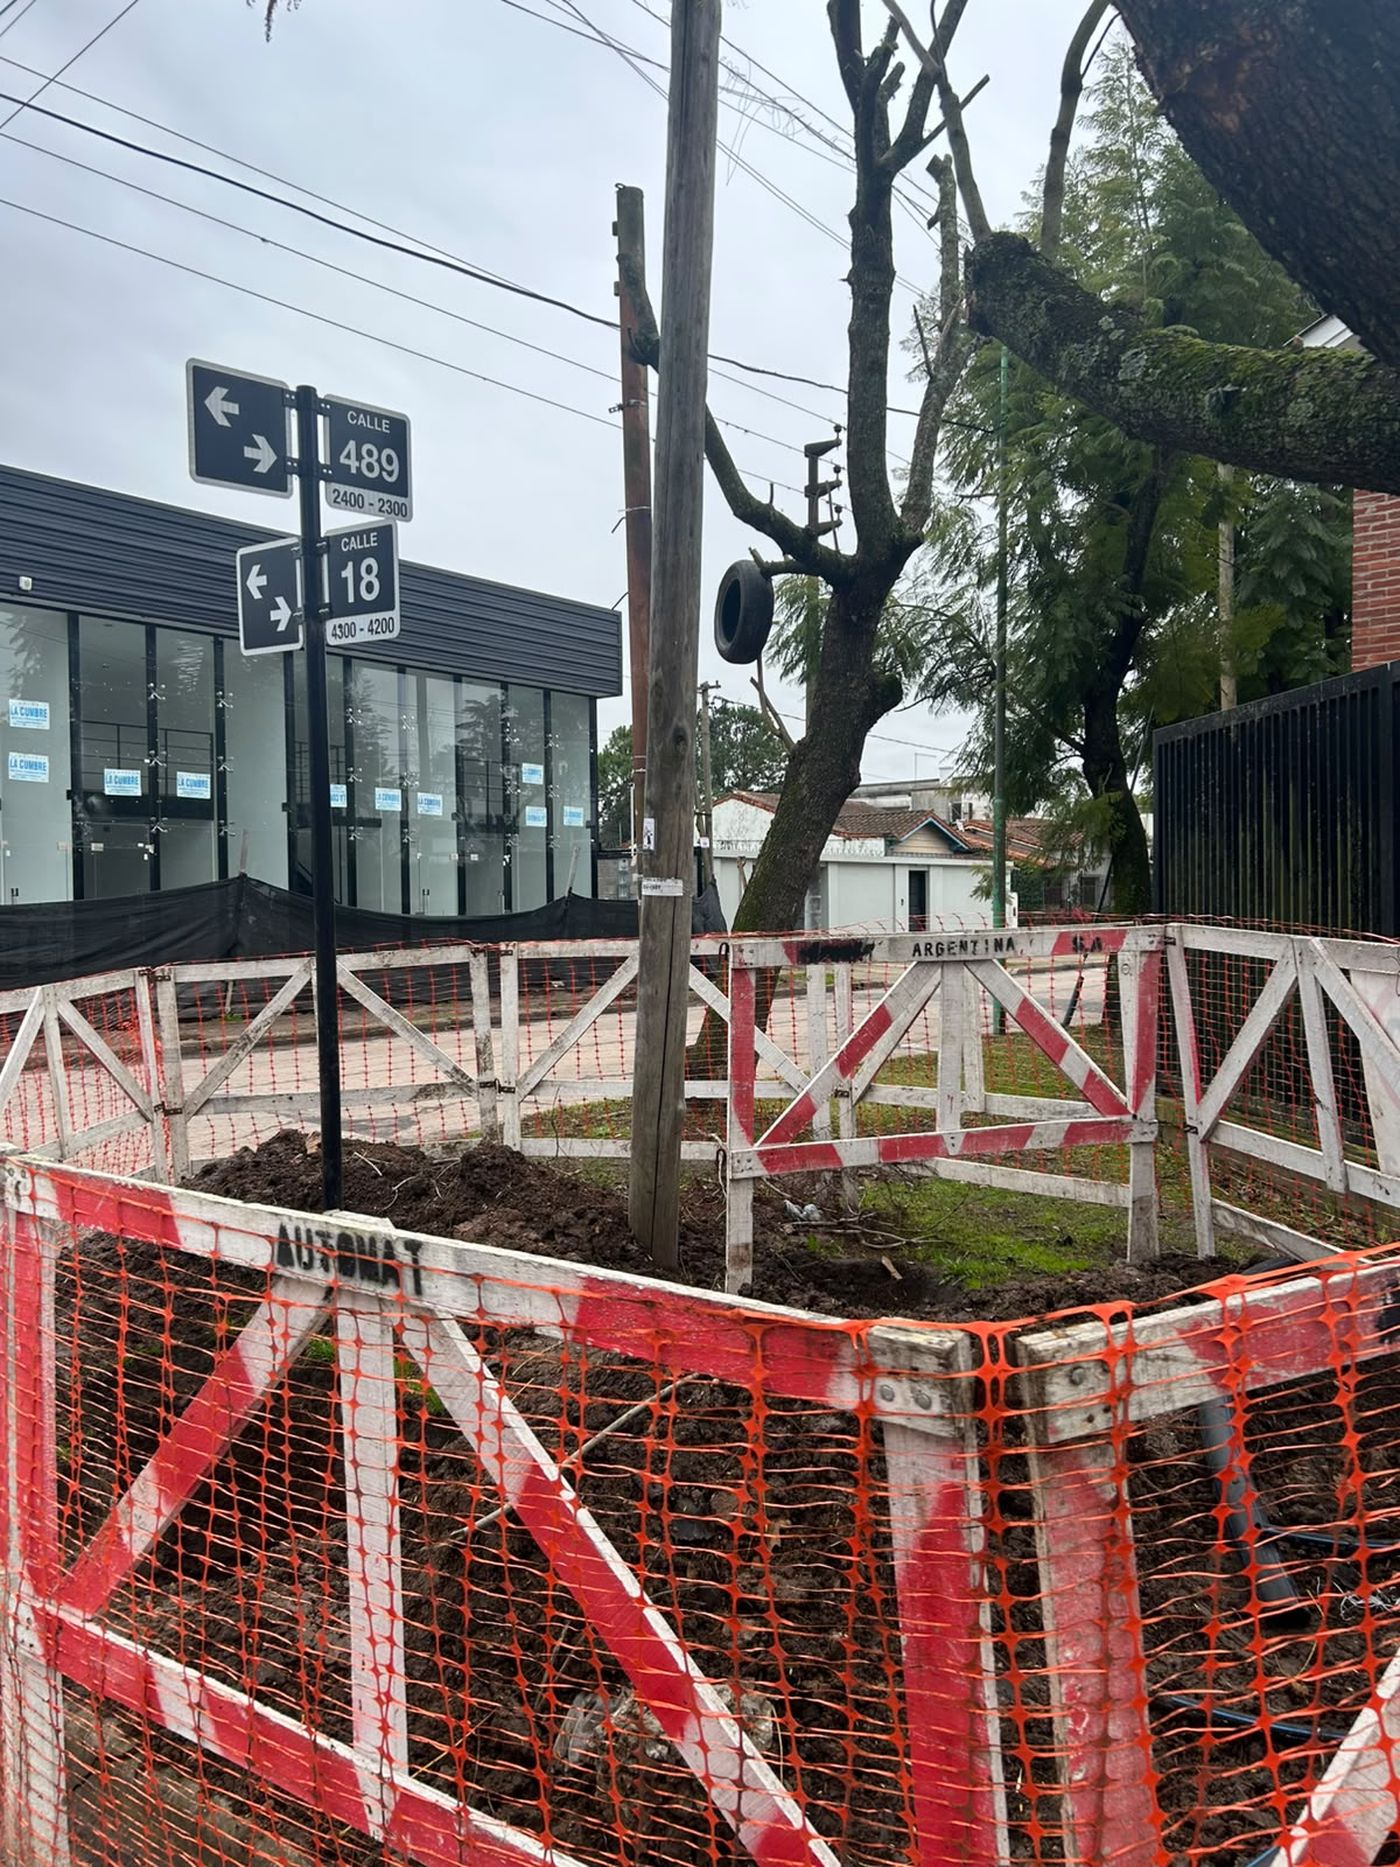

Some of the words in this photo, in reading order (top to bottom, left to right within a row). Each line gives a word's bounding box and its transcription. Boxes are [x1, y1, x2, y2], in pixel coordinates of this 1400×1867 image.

[347, 410, 391, 434] CALLE
[339, 439, 400, 483] 489
[332, 488, 365, 510] 2400
[377, 497, 408, 518] 2300
[340, 532, 378, 552] CALLE
[340, 556, 380, 604] 18
[331, 620, 357, 641] 4300
[367, 616, 395, 637] 4200
[10, 705, 19, 715] LA
[20, 706, 47, 718] CUMBRE
[10, 758, 18, 768] LA
[19, 759, 47, 772] CUMBRE
[912, 936, 1015, 957] ARGENTINA
